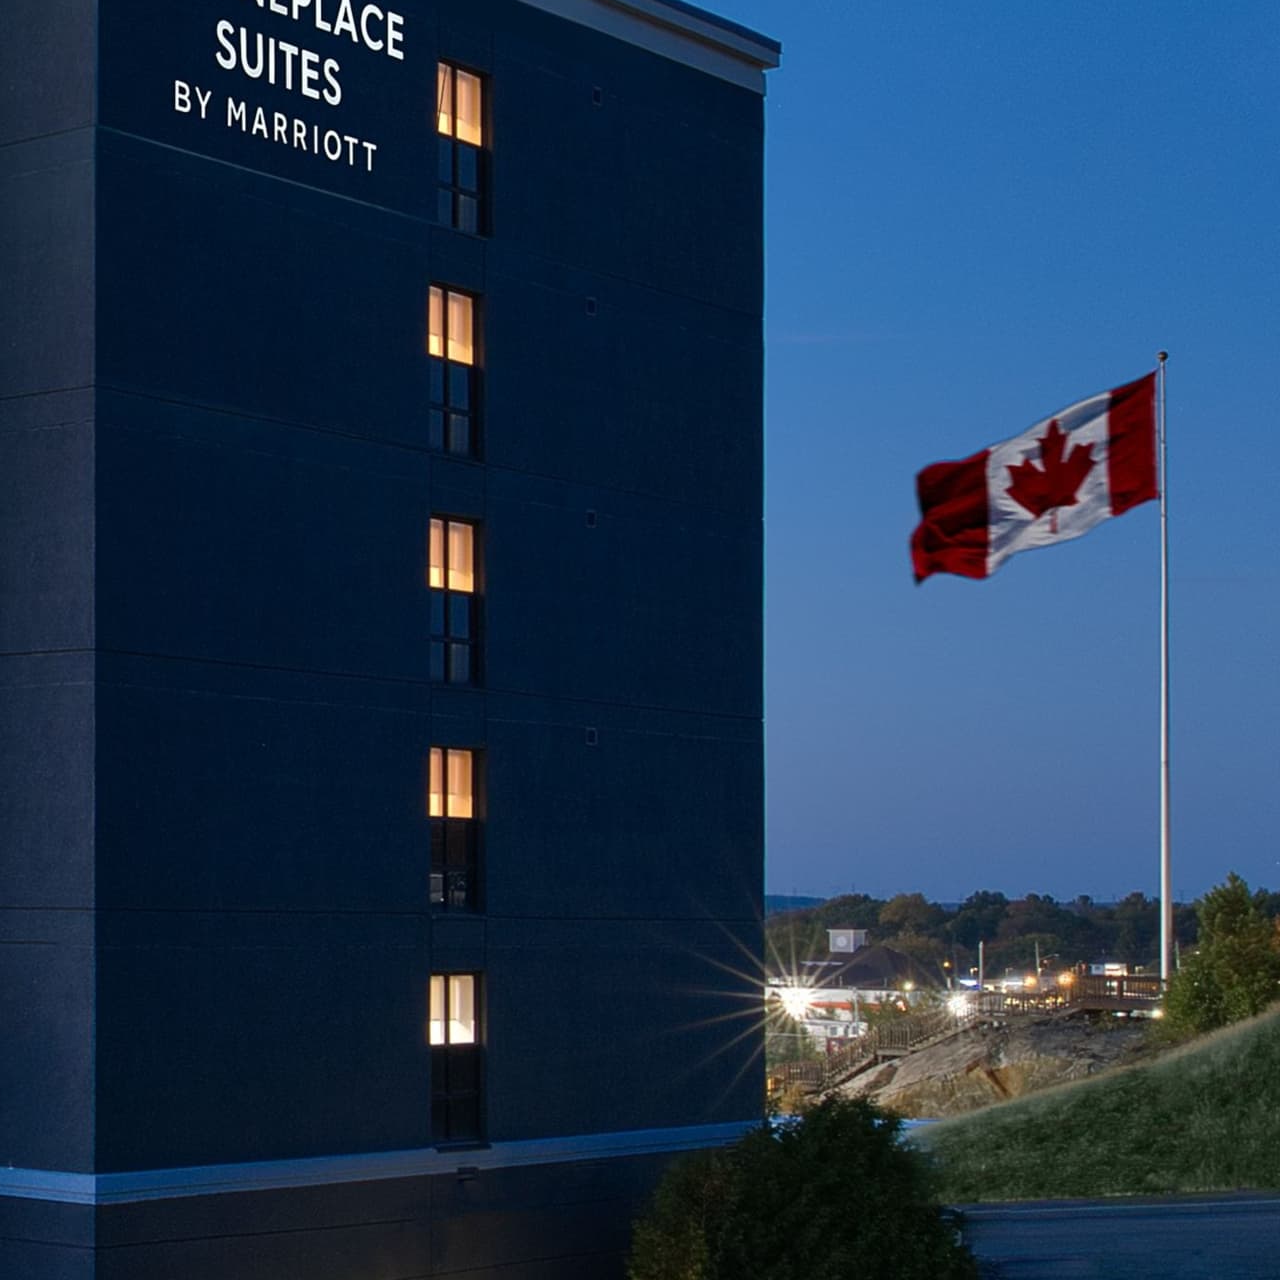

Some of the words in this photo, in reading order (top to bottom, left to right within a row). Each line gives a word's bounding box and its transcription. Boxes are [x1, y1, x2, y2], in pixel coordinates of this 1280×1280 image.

[215, 19, 342, 106] SUITES
[174, 79, 212, 119] BY
[227, 97, 377, 172] MARRIOTT
